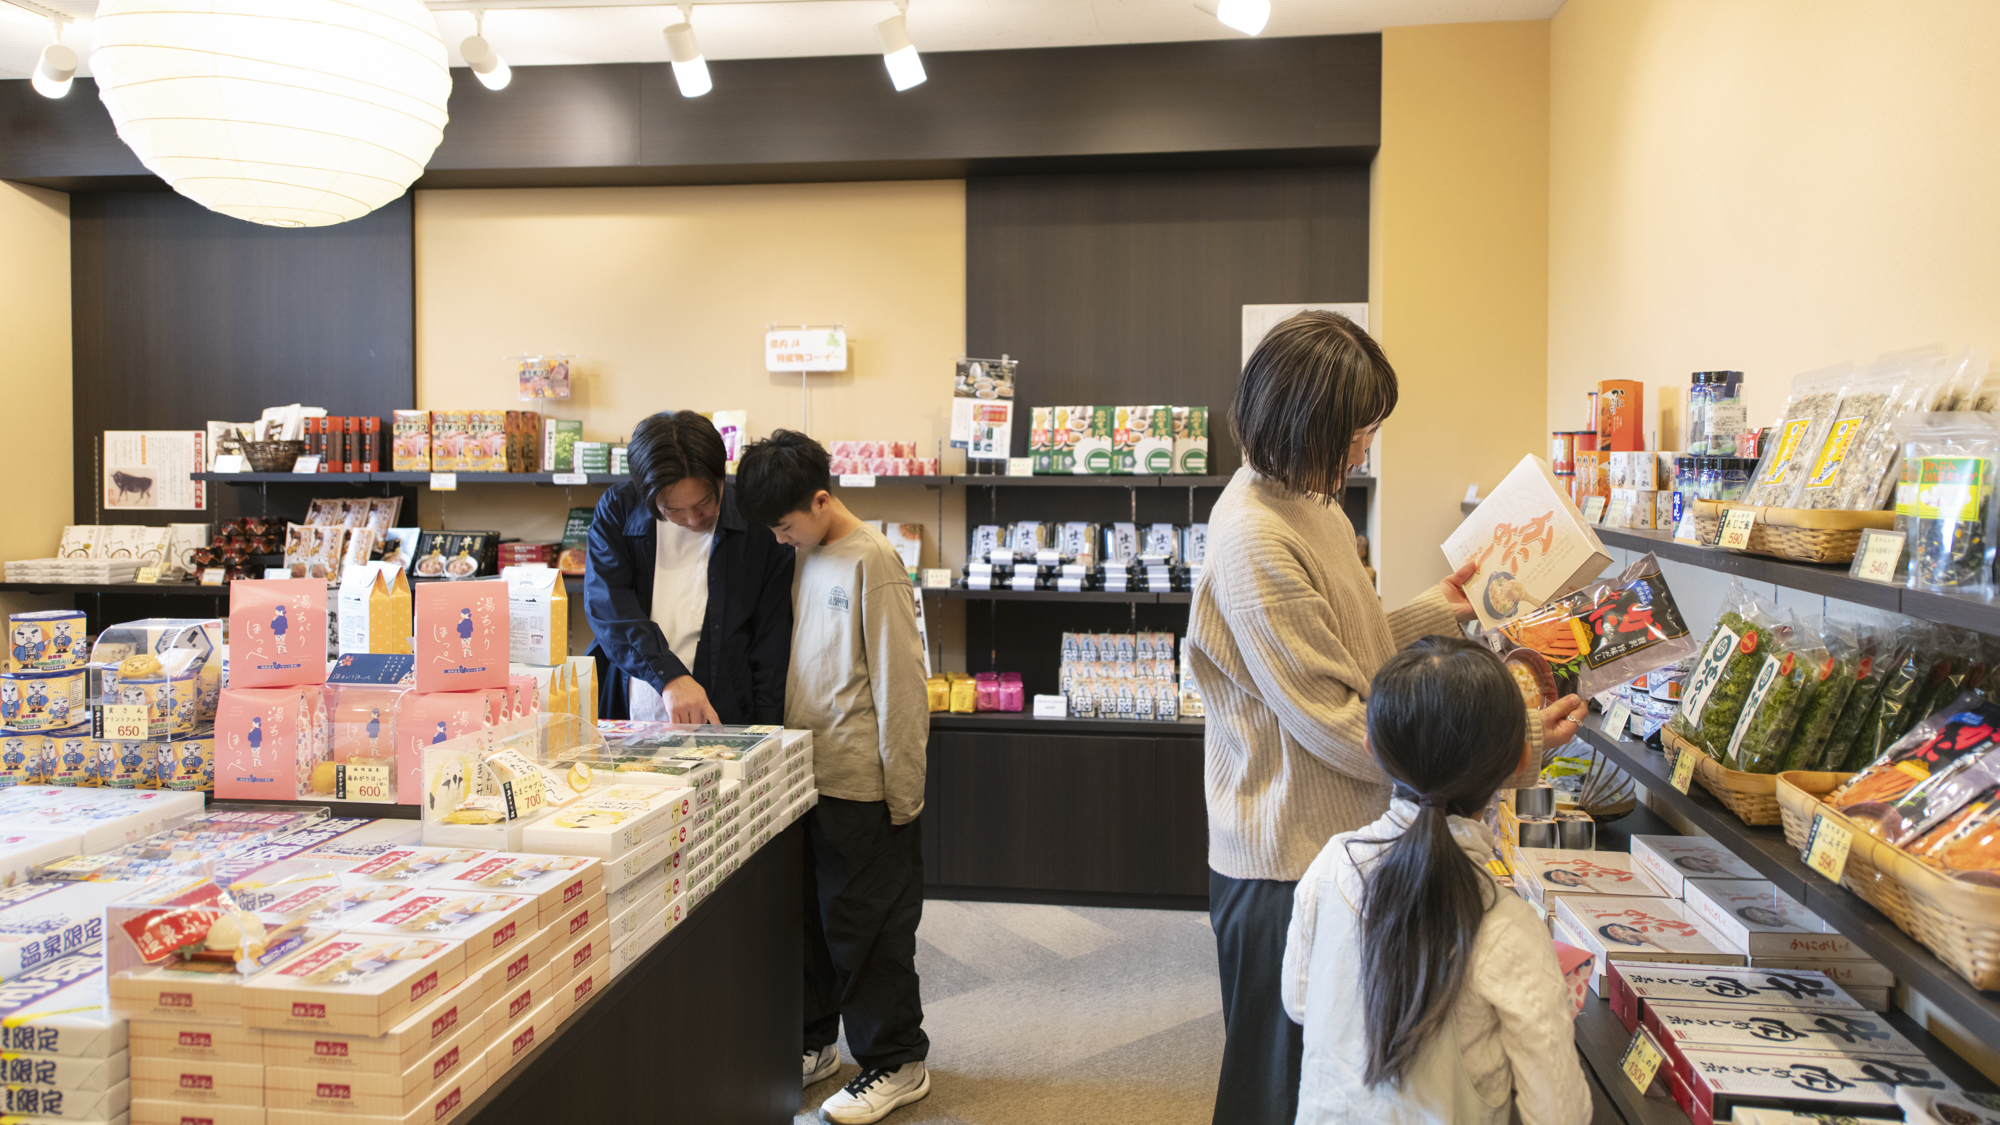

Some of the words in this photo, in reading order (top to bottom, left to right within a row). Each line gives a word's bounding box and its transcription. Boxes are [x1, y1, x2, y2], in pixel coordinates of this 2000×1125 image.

[790, 339, 800, 348] JA
[776, 353, 843, 363] 特産物コーナー
[1728, 532, 1743, 545] 590
[1869, 560, 1889, 575] 540
[292, 594, 312, 648] 湯あがり
[477, 596, 495, 651] 湯あがり
[246, 620, 269, 660] ほっぺ
[433, 624, 455, 664] ほっぺ
[118, 726, 139, 737] 650
[268, 706, 285, 762] 湯あがり
[227, 731, 246, 772] ほっぺ
[360, 786, 380, 797] 600
[1676, 772, 1688, 789] 540
[524, 793, 541, 809] 700
[1817, 852, 1837, 874] 590
[137, 895, 240, 956] 温泉ぷり
[20, 917, 102, 969] 温泉限定
[1666, 1012, 1891, 1044] 牛肉めしの素
[1627, 1060, 1646, 1086] 1300
